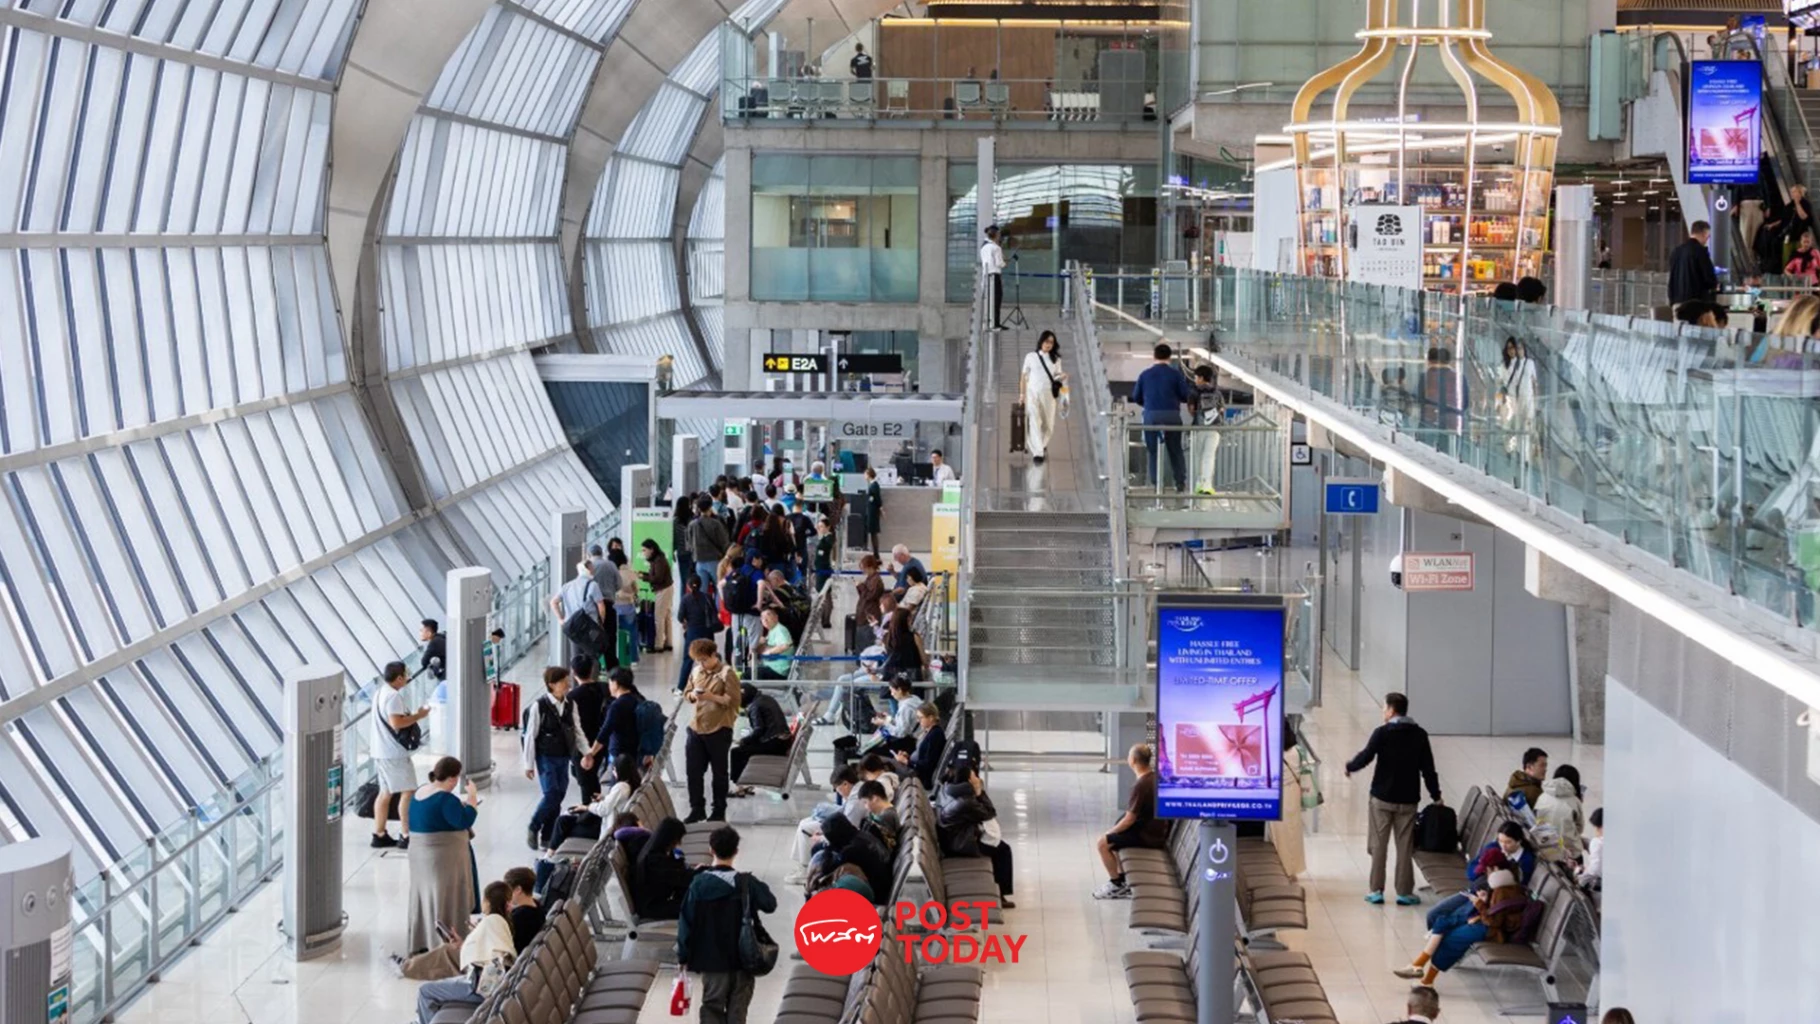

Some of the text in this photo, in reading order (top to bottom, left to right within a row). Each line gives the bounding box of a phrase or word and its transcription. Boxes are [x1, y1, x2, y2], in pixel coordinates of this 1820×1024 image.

[792, 357, 818, 370] E2A
[843, 422, 902, 437] Gate E2
[1440, 573, 1468, 585] Zone
[1221, 640, 1240, 648] FREE
[1177, 648, 1253, 657] LIVING IN THAILAND
[1189, 656, 1230, 665] UNLIMITED
[1230, 657, 1262, 665] ENTRIES
[1229, 676, 1258, 686] OFFER
